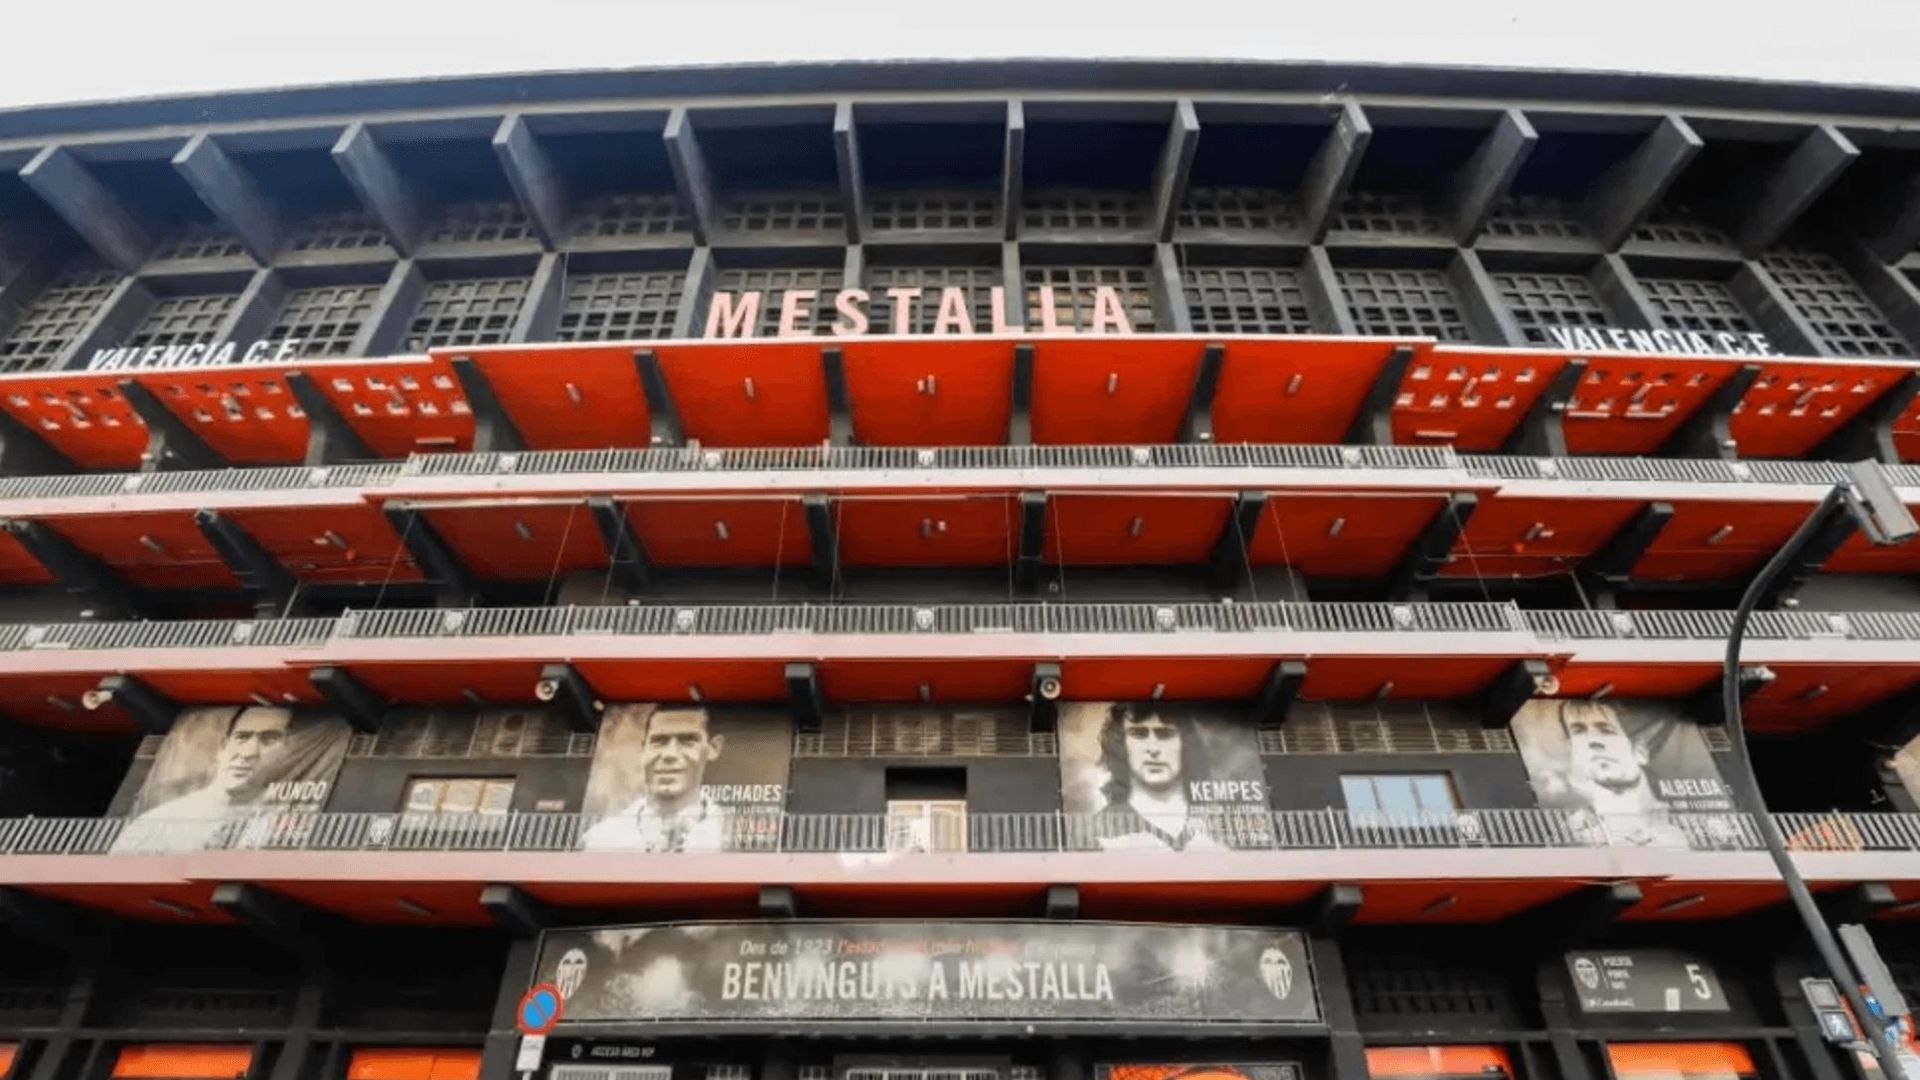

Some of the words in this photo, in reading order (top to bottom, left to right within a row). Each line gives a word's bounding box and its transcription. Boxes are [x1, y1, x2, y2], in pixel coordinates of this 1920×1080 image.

[704, 286, 1135, 338] MESTALLA
[86, 340, 237, 370] VALENCIA
[1549, 327, 1713, 355] VALENCIA
[264, 781, 327, 801] MUNDO
[1190, 781, 1264, 802] KEMPES
[1659, 779, 1723, 797] ALBELDA
[740, 939, 765, 956] Des
[770, 940, 788, 955] de
[794, 938, 833, 957] 1923
[722, 961, 917, 1001] BENVINGUTS
[928, 960, 947, 1001] A
[959, 961, 1114, 1001] MESTALLA
[1685, 964, 1712, 1000] 5
